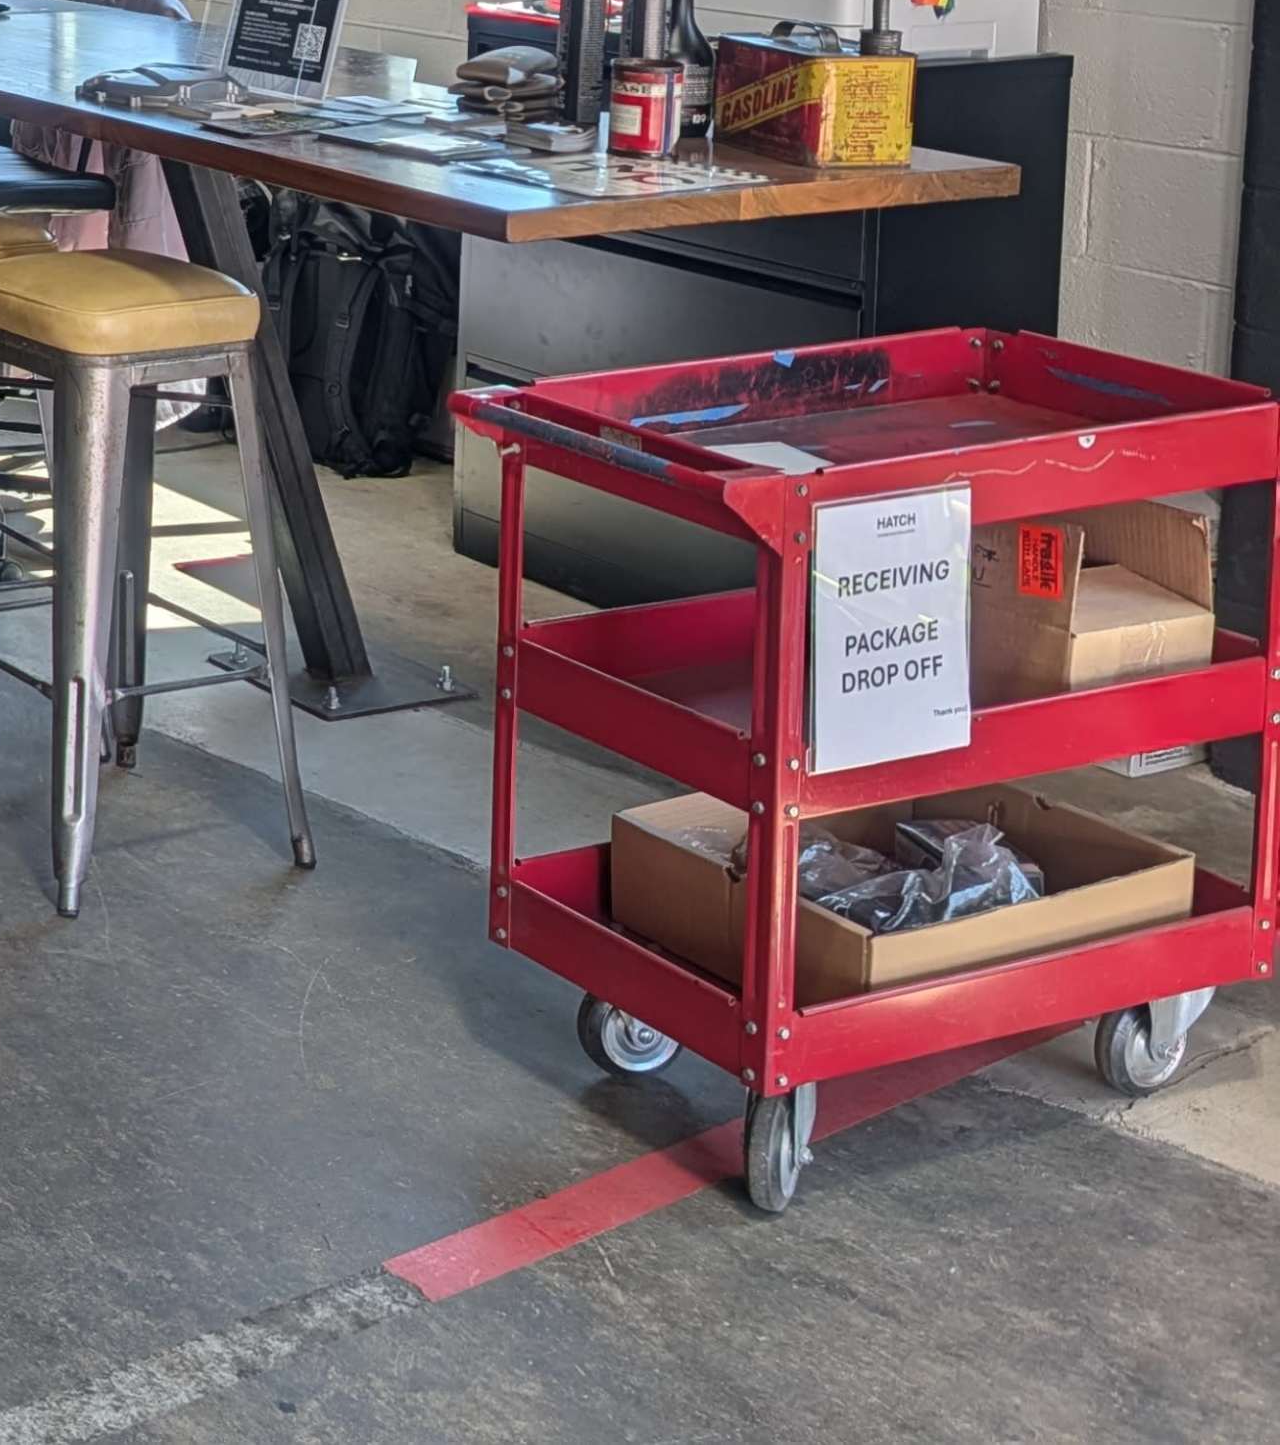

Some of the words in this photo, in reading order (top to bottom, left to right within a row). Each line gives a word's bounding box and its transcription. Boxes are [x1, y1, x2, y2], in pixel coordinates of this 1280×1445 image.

[720, 74, 800, 130] GASOLINE
[876, 513, 917, 531] HATCH
[837, 559, 951, 599] RECEIVING
[844, 619, 940, 657] PACKAGE
[841, 662, 900, 694] DROP
[903, 654, 944, 683] OFF
[933, 707, 954, 718] Thank
